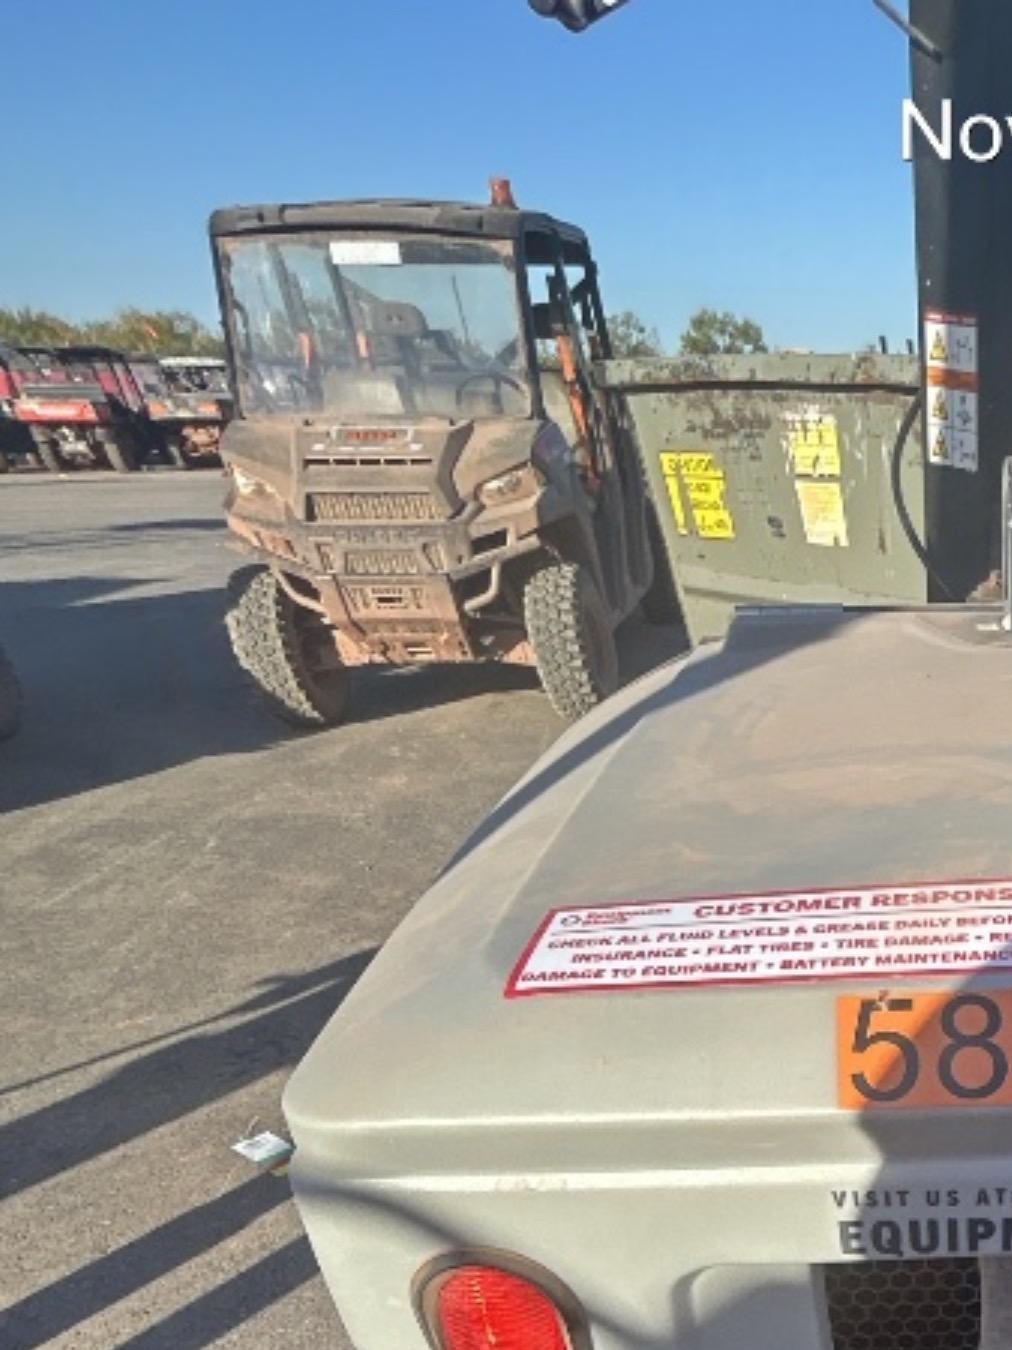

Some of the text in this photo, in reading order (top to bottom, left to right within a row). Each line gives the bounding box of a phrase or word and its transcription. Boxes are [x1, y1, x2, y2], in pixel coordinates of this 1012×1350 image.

[695, 896, 861, 918] CUSTOMER
[548, 937, 612, 950] CHECK
[615, 935, 651, 946] ALL
[718, 926, 789, 939] LEVELS
[813, 920, 890, 934] GREASE
[895, 917, 951, 930] DAILY
[571, 947, 688, 964] INSURANCE
[707, 943, 753, 955] FLAT
[760, 941, 814, 952] TIRES
[835, 937, 878, 950] TIRE
[884, 932, 969, 947] DAMAGE
[521, 968, 606, 982] DAMAGE
[612, 967, 636, 979] TO
[641, 959, 758, 976] EQUIPMENT
[779, 956, 870, 970] BATTERY
[831, 1189, 910, 1208] VISIT
[926, 1189, 961, 1207] US
